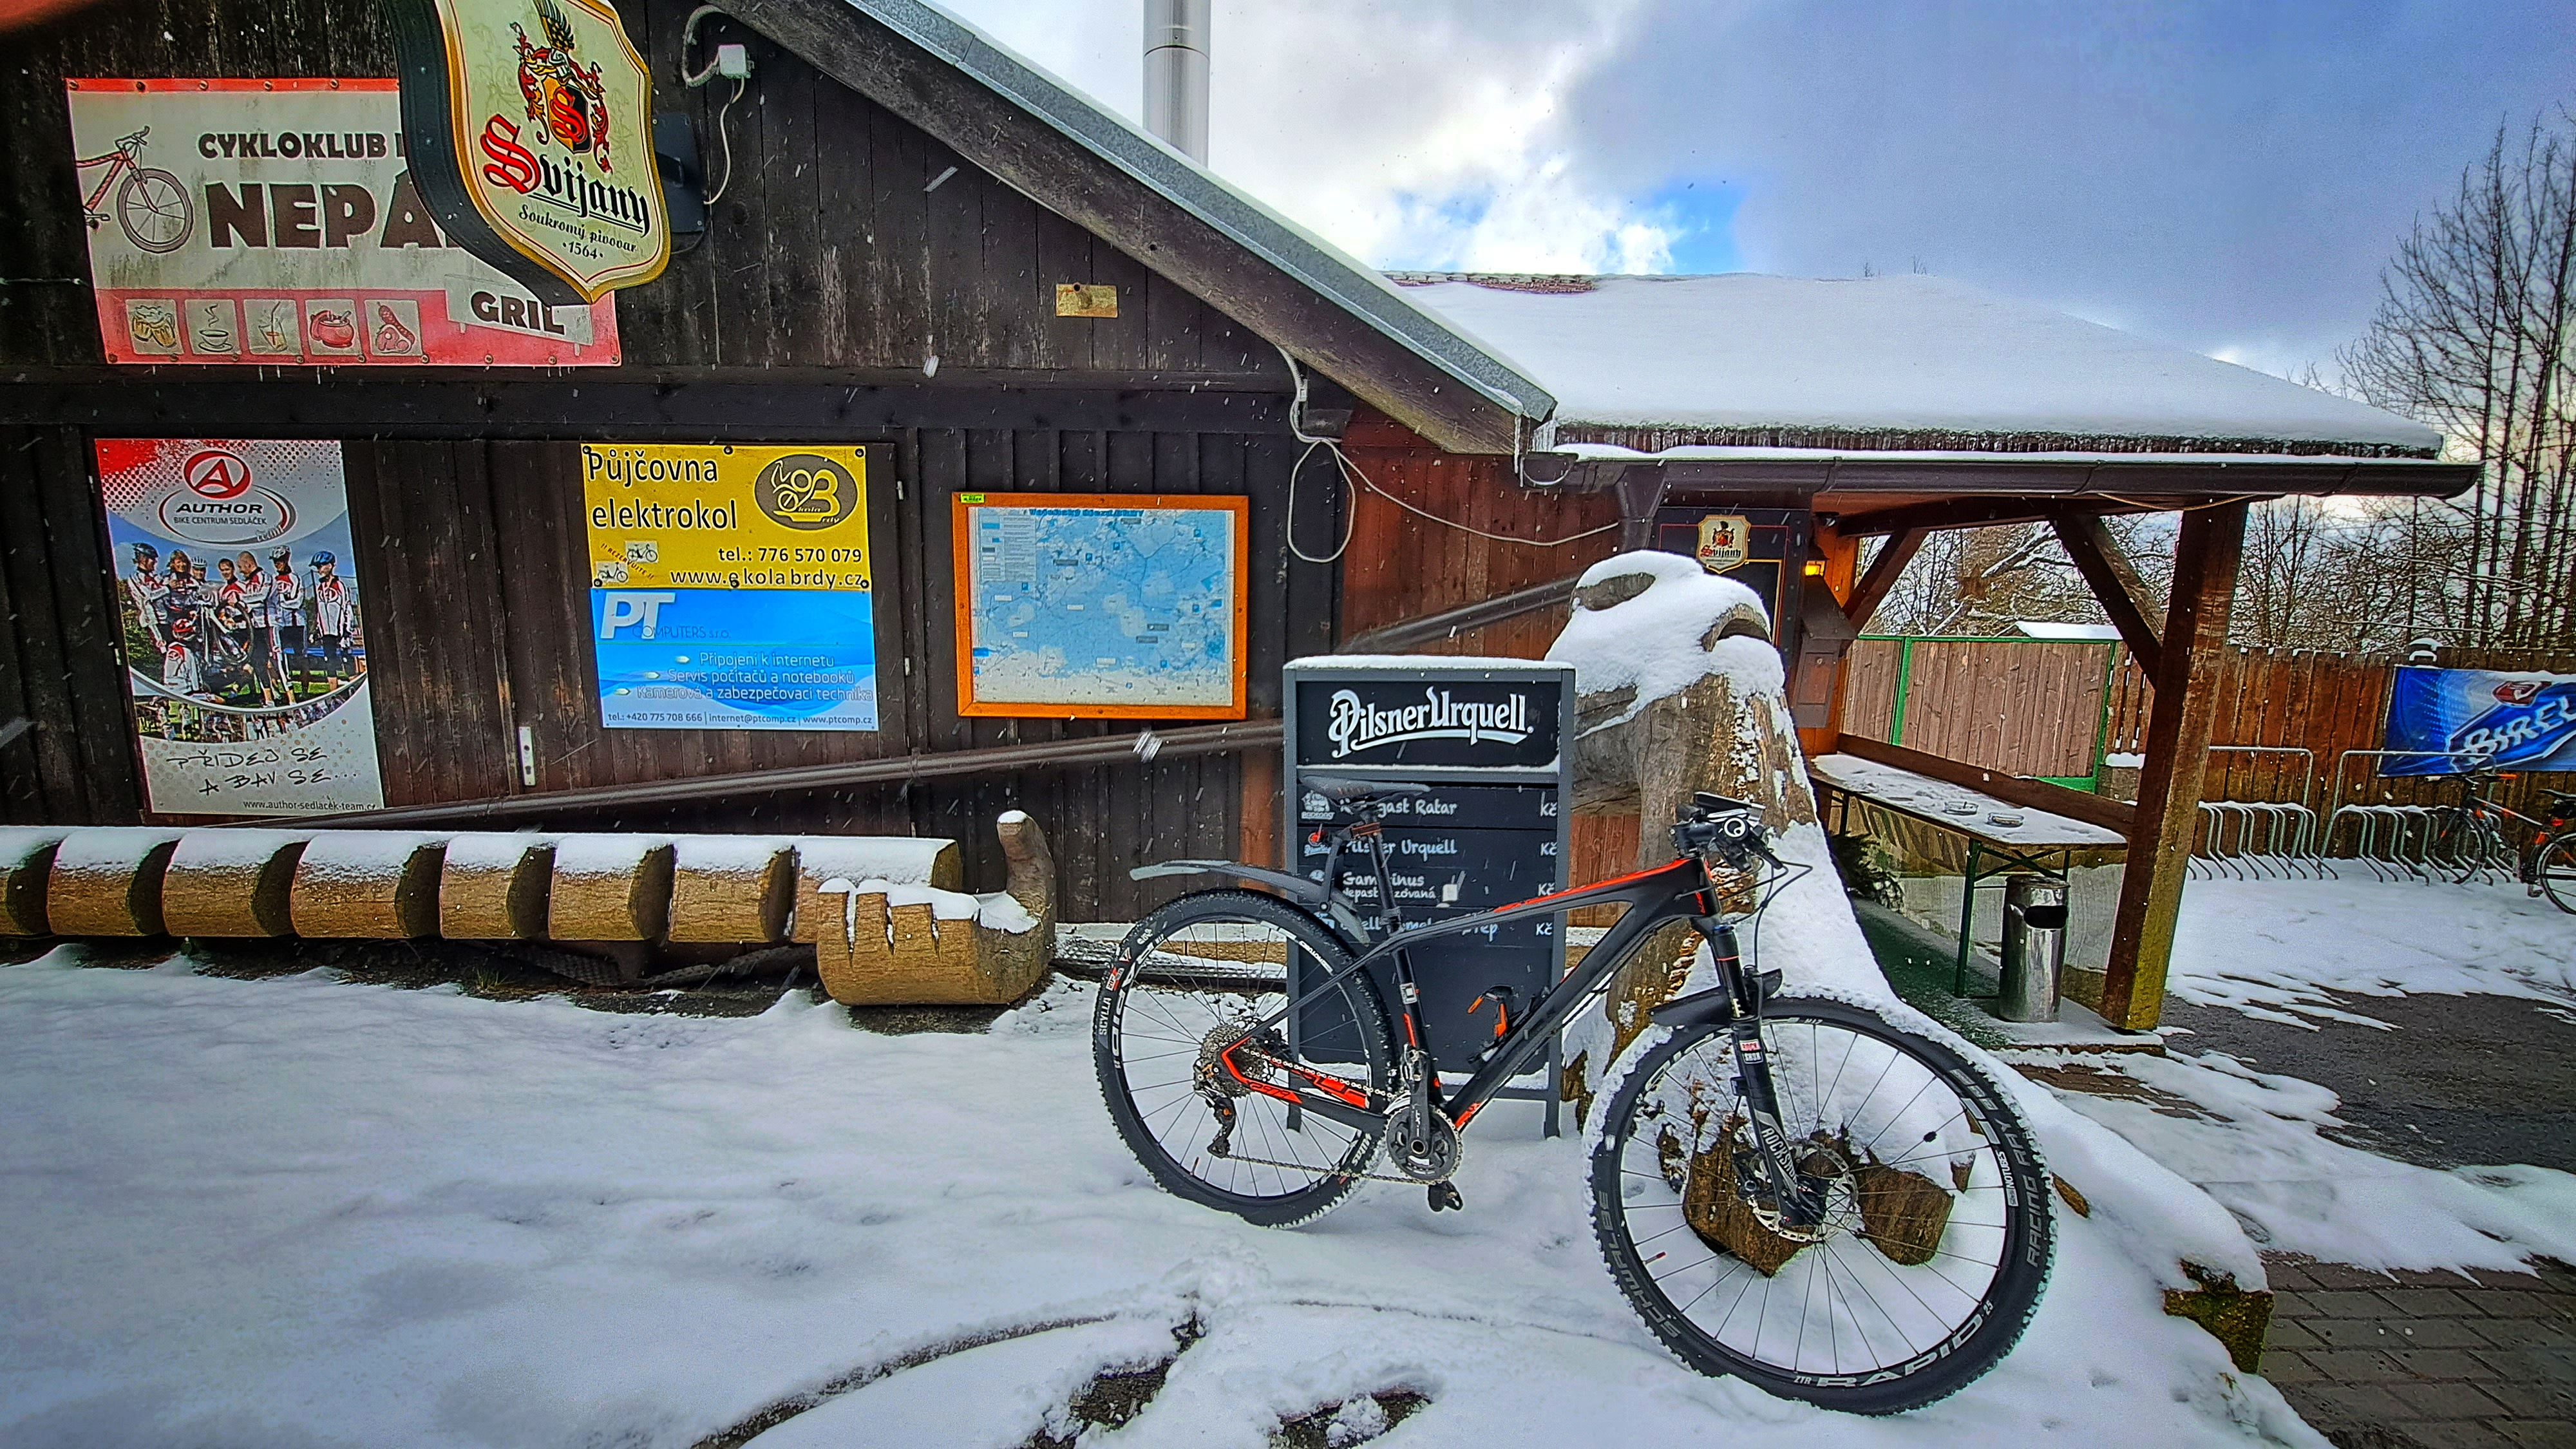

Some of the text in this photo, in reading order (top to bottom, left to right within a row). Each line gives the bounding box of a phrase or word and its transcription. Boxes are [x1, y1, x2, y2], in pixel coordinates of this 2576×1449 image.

[198, 133, 386, 158] CYKLOKLUB
[480, 113, 650, 238] Svijany
[204, 169, 465, 249] NEPA
[518, 205, 636, 252] Soukromý pivovar
[471, 291, 565, 335] GRIL
[588, 449, 718, 486] Půjčovna
[176, 504, 263, 514] AUTHOR
[192, 516, 229, 525] CENTRUM
[592, 499, 737, 529] elektrokol
[719, 547, 861, 562] tel.: 776 570 079
[600, 592, 676, 639] PT
[632, 625, 706, 638] COMPUTERS
[700, 652, 834, 670] Připojení k internetu
[667, 668, 855, 685] Servis počítačů a notebooků
[637, 685, 873, 701] Kamerová a zabezpečovací technika
[626, 713, 648, 721] +420
[650, 713, 665, 721] 775
[667, 713, 684, 722] 708
[686, 713, 703, 722] 666
[709, 714, 796, 724] internet@ptcomp.cz
[804, 716, 872, 725] www.ptcomp.cz
[1328, 686, 1527, 759] Pilsner Urquell
[166, 747, 327, 769] PŘIDEJ SE
[199, 779, 220, 795] A
[225, 771, 276, 788] BAV
[1416, 799, 1457, 815] Ratar
[1540, 841, 1557, 856] Kč
[1538, 883, 1555, 896] Kč
[1536, 922, 1553, 936] Kč
[1099, 997, 1112, 1036] SCYLLA
[1994, 1118, 2031, 1167] RAY
[1995, 1151, 2014, 1189] NOTUBES
[2023, 1174, 2043, 1267] RACING
[1599, 1191, 1681, 1338] SCHWALBE
[1816, 1314, 1983, 1387] RAPID
